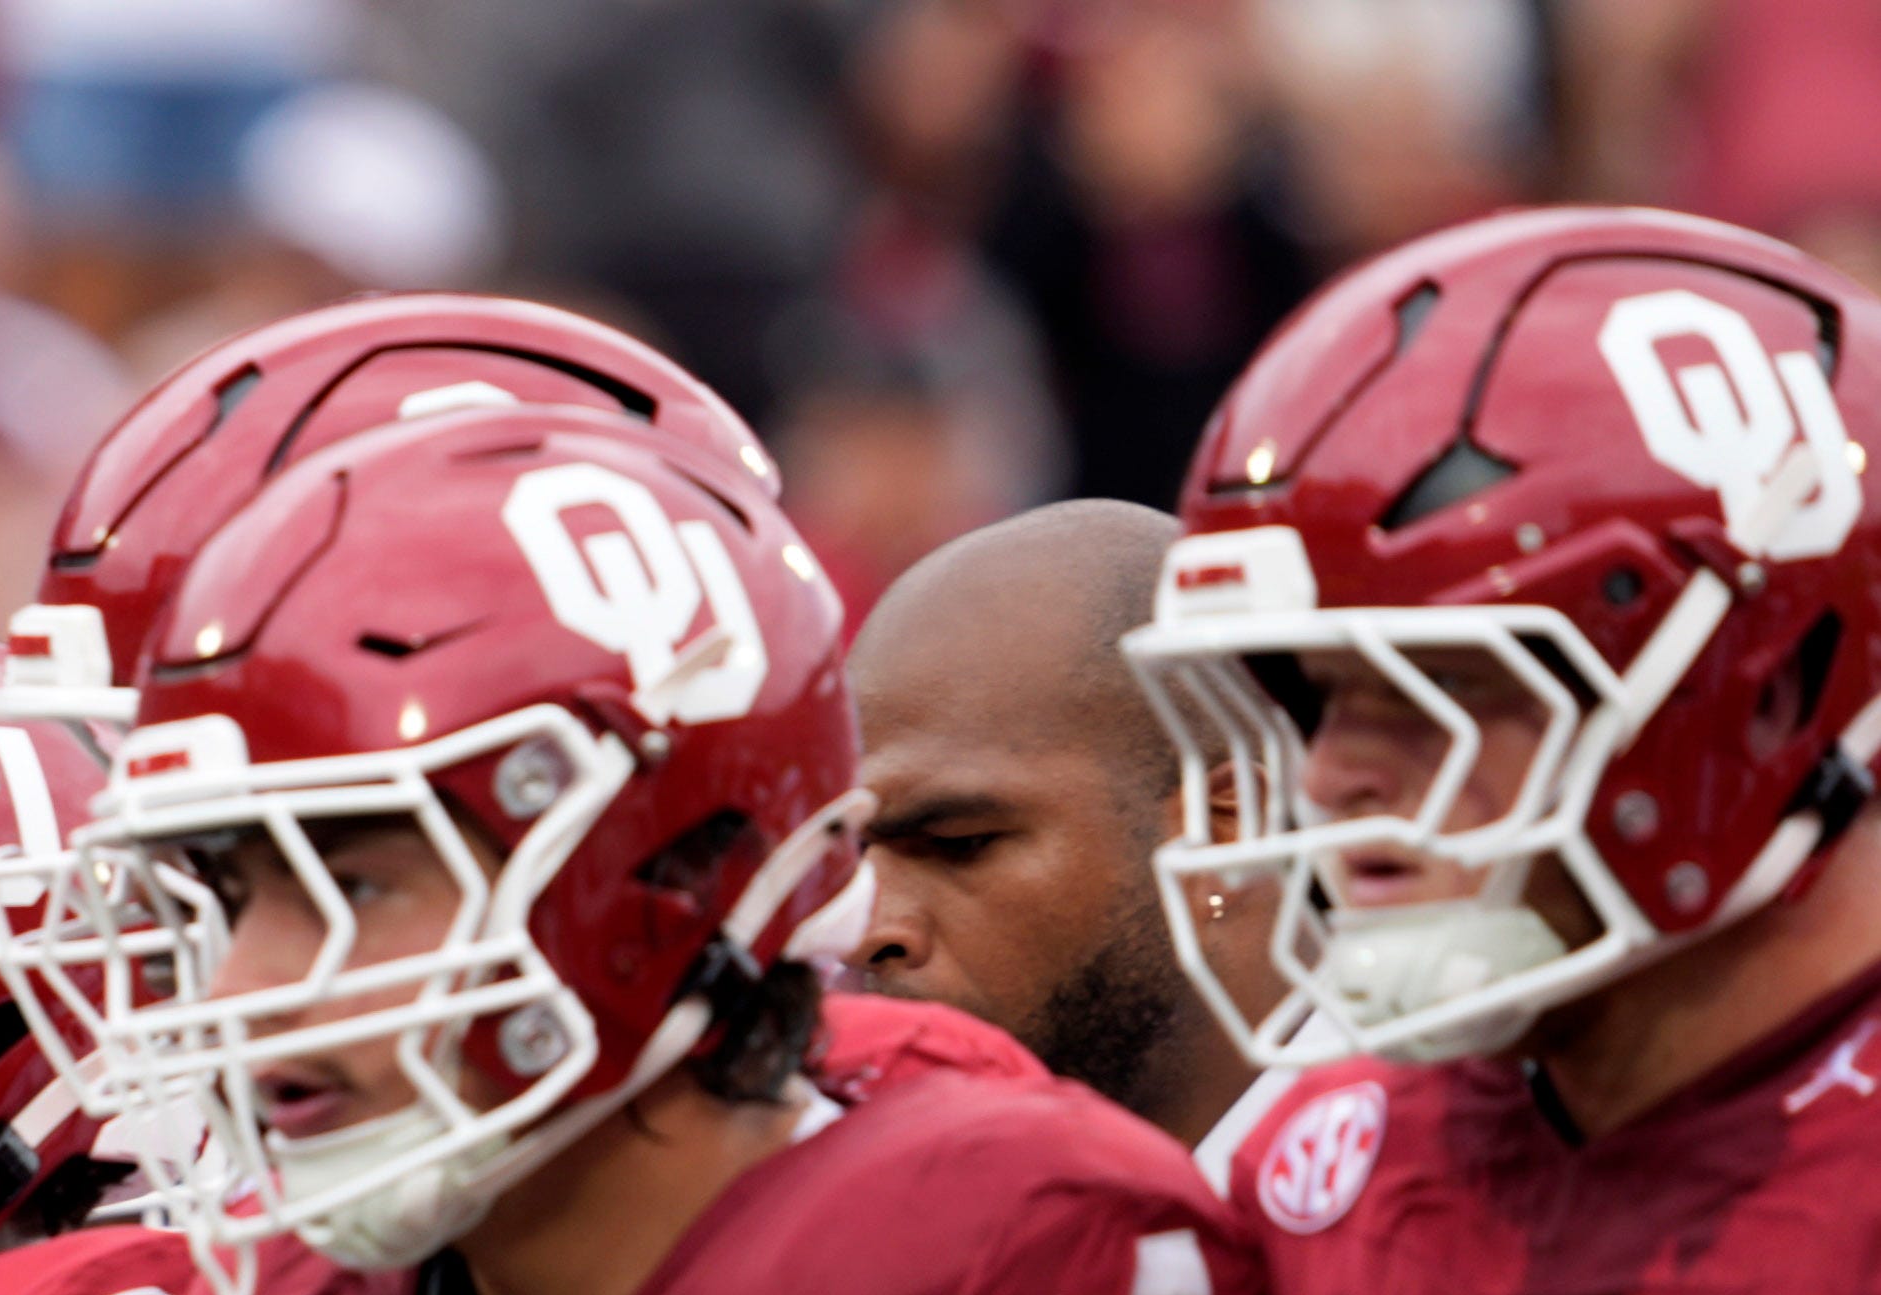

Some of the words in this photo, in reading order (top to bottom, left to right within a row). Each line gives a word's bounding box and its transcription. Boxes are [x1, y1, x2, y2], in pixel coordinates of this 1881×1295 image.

[1598, 289, 1863, 561] OU
[501, 462, 769, 725] OU
[1270, 1091, 1380, 1213] SEC
